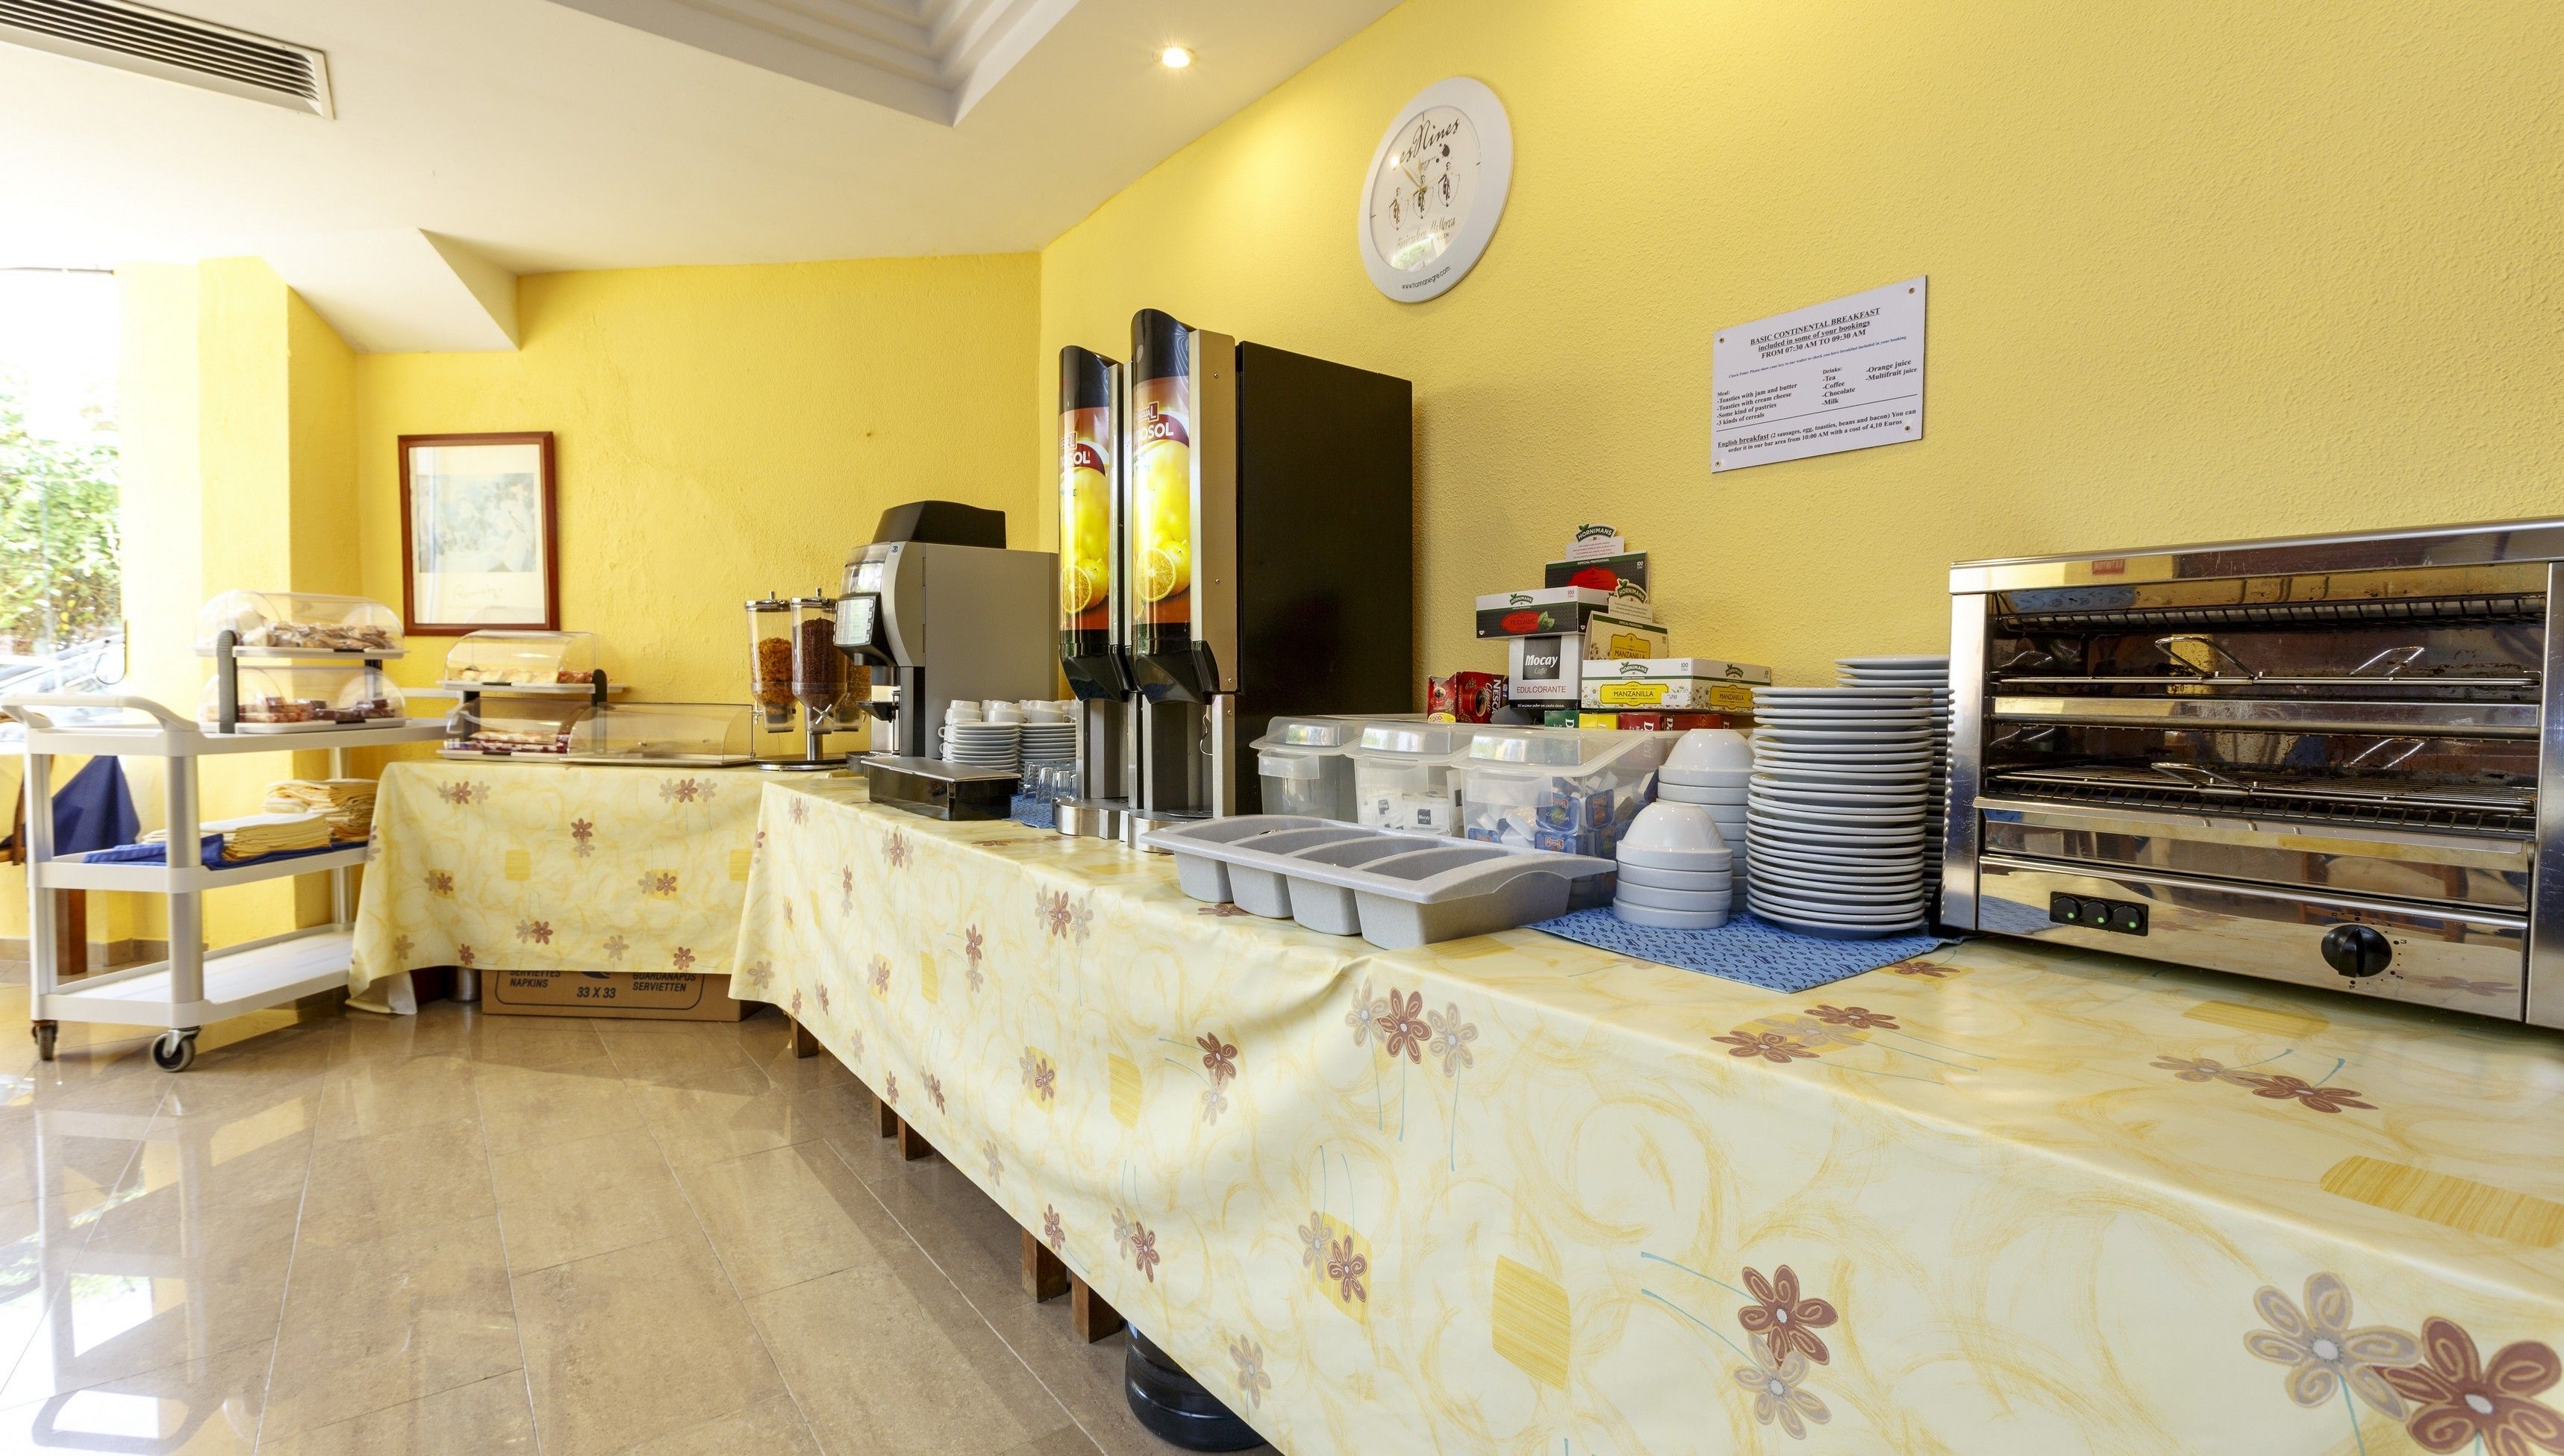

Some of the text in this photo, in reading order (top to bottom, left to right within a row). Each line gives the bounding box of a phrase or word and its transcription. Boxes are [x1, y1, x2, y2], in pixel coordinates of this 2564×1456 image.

[1750, 307, 1880, 346] BASIC CONTINENTAL BREAKFAST
[1758, 340, 1785, 351] included
[1821, 328, 1837, 337] your
[1838, 320, 1871, 332] bookings
[1762, 348, 1784, 358] FROM
[1785, 344, 1803, 353] 07:30
[1804, 340, 1817, 349] AM
[1818, 337, 1830, 346] TO
[1832, 333, 1851, 343] 09:30
[1822, 366, 1842, 375] Drinks:
[1865, 360, 1912, 373] -Orange juice
[1865, 367, 1918, 381] -Multifruit juice
[1822, 381, 1845, 390] -Coffee
[1717, 395, 1740, 404] -Toasties
[1754, 390, 1766, 398] jam
[1779, 383, 1797, 391] butter
[1821, 387, 1856, 398] -Chocolate
[1717, 402, 1740, 411] -Toasties
[1755, 402, 1777, 413] pastries
[1821, 398, 1839, 406] -Milk
[1723, 417, 1738, 425] kinds
[1718, 440, 1738, 449] English
[1738, 434, 1769, 445] breakfast
[1838, 419, 1856, 427] beans
[1869, 413, 1890, 422] bacon)
[1578, 528, 1612, 540] HORNIMANS
[1618, 587, 1645, 601] HORNIMANS
[1615, 650, 1645, 659] MANZANILLA
[1525, 654, 1559, 667] Mocay
[1621, 664, 1647, 674] HORNIMANS
[1719, 693, 1744, 701] MANZANILLA
[509, 978, 549, 988] NAPKINS
[633, 982, 687, 992] SERVIETTEN
[577, 987, 617, 999] 33 X 33
